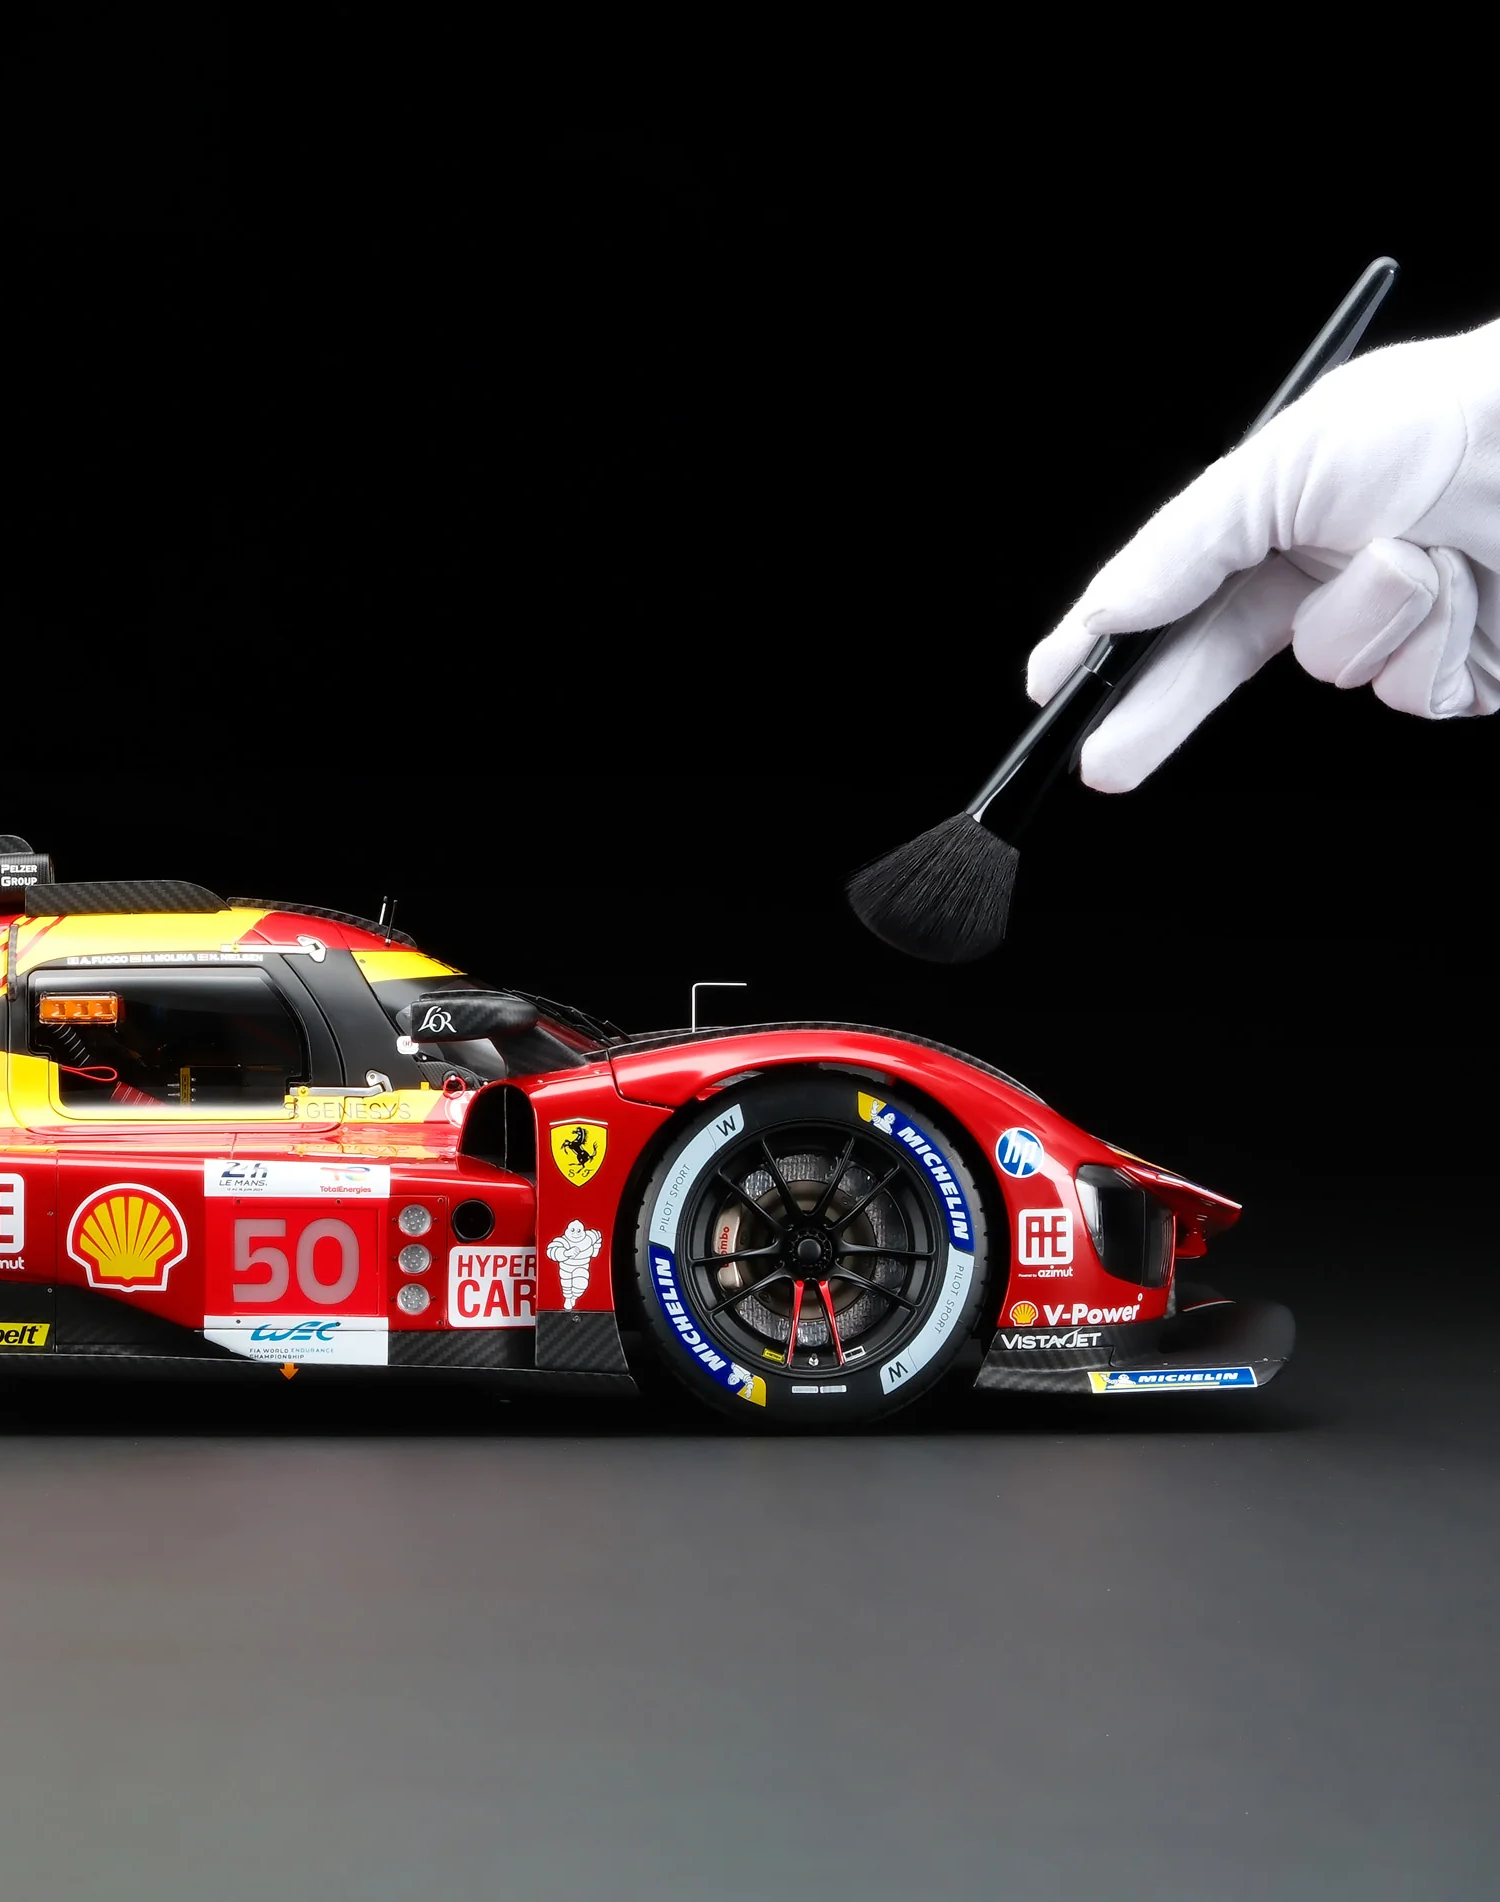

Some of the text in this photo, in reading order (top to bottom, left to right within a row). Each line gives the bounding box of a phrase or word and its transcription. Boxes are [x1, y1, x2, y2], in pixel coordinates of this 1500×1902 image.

[1, 864, 37, 873] PELZER
[1, 876, 38, 887] GROUP
[155, 953, 195, 963] MOLINA
[220, 953, 264, 962] NIELSEN
[306, 1102, 412, 1120] GENESYS
[716, 1115, 737, 1137] W
[1003, 1128, 1037, 1178] hp
[219, 1179, 232, 1187] LE
[320, 1185, 372, 1195] TotalEnergies
[897, 1126, 970, 1240] MICHELIN
[660, 1164, 691, 1232] PILOT SPORT
[234, 1218, 360, 1304] 50
[457, 1255, 537, 1277] HYPER
[1037, 1265, 1074, 1278] azimut
[456, 1279, 537, 1319] CAR
[934, 1264, 964, 1334] PILOT SPORT
[654, 1257, 727, 1372] MICHELIN
[1043, 1303, 1140, 1325] V-Power
[250, 1320, 340, 1341] WEC
[888, 1361, 909, 1383] W
[1138, 1372, 1239, 1383] MICHELIN
